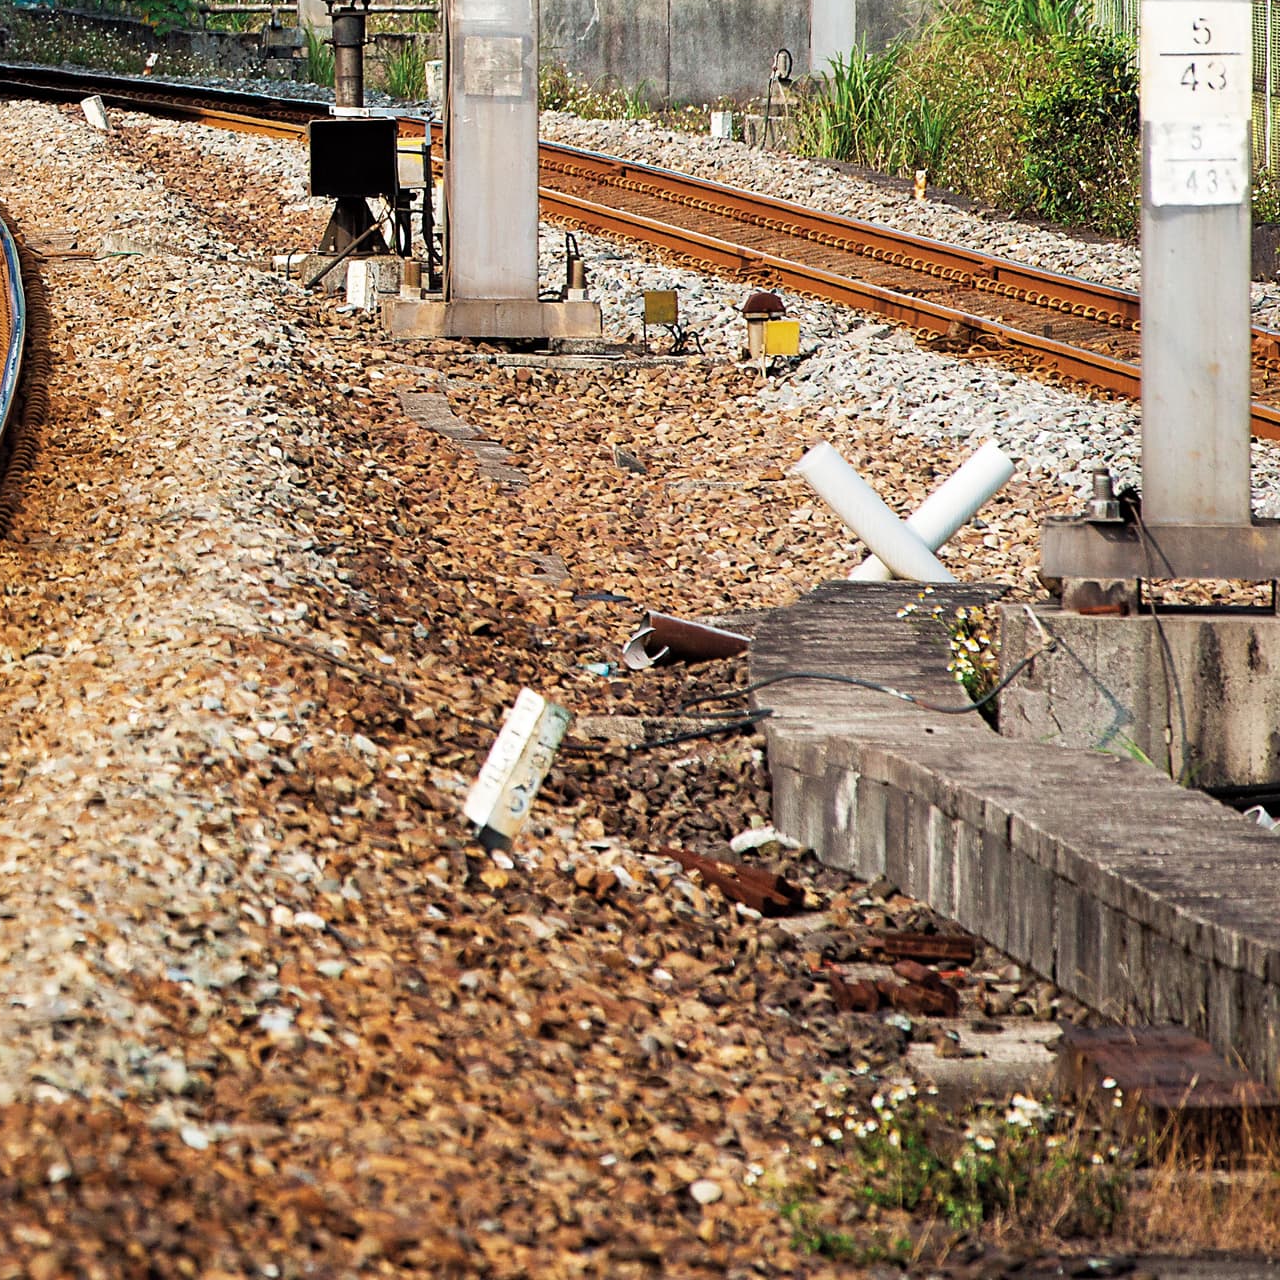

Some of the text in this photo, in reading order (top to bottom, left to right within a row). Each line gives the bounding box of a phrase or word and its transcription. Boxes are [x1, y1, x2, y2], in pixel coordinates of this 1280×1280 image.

[1192, 18, 1212, 45] 5
[1180, 61, 1227, 91] 43
[1191, 125, 1202, 151] 5
